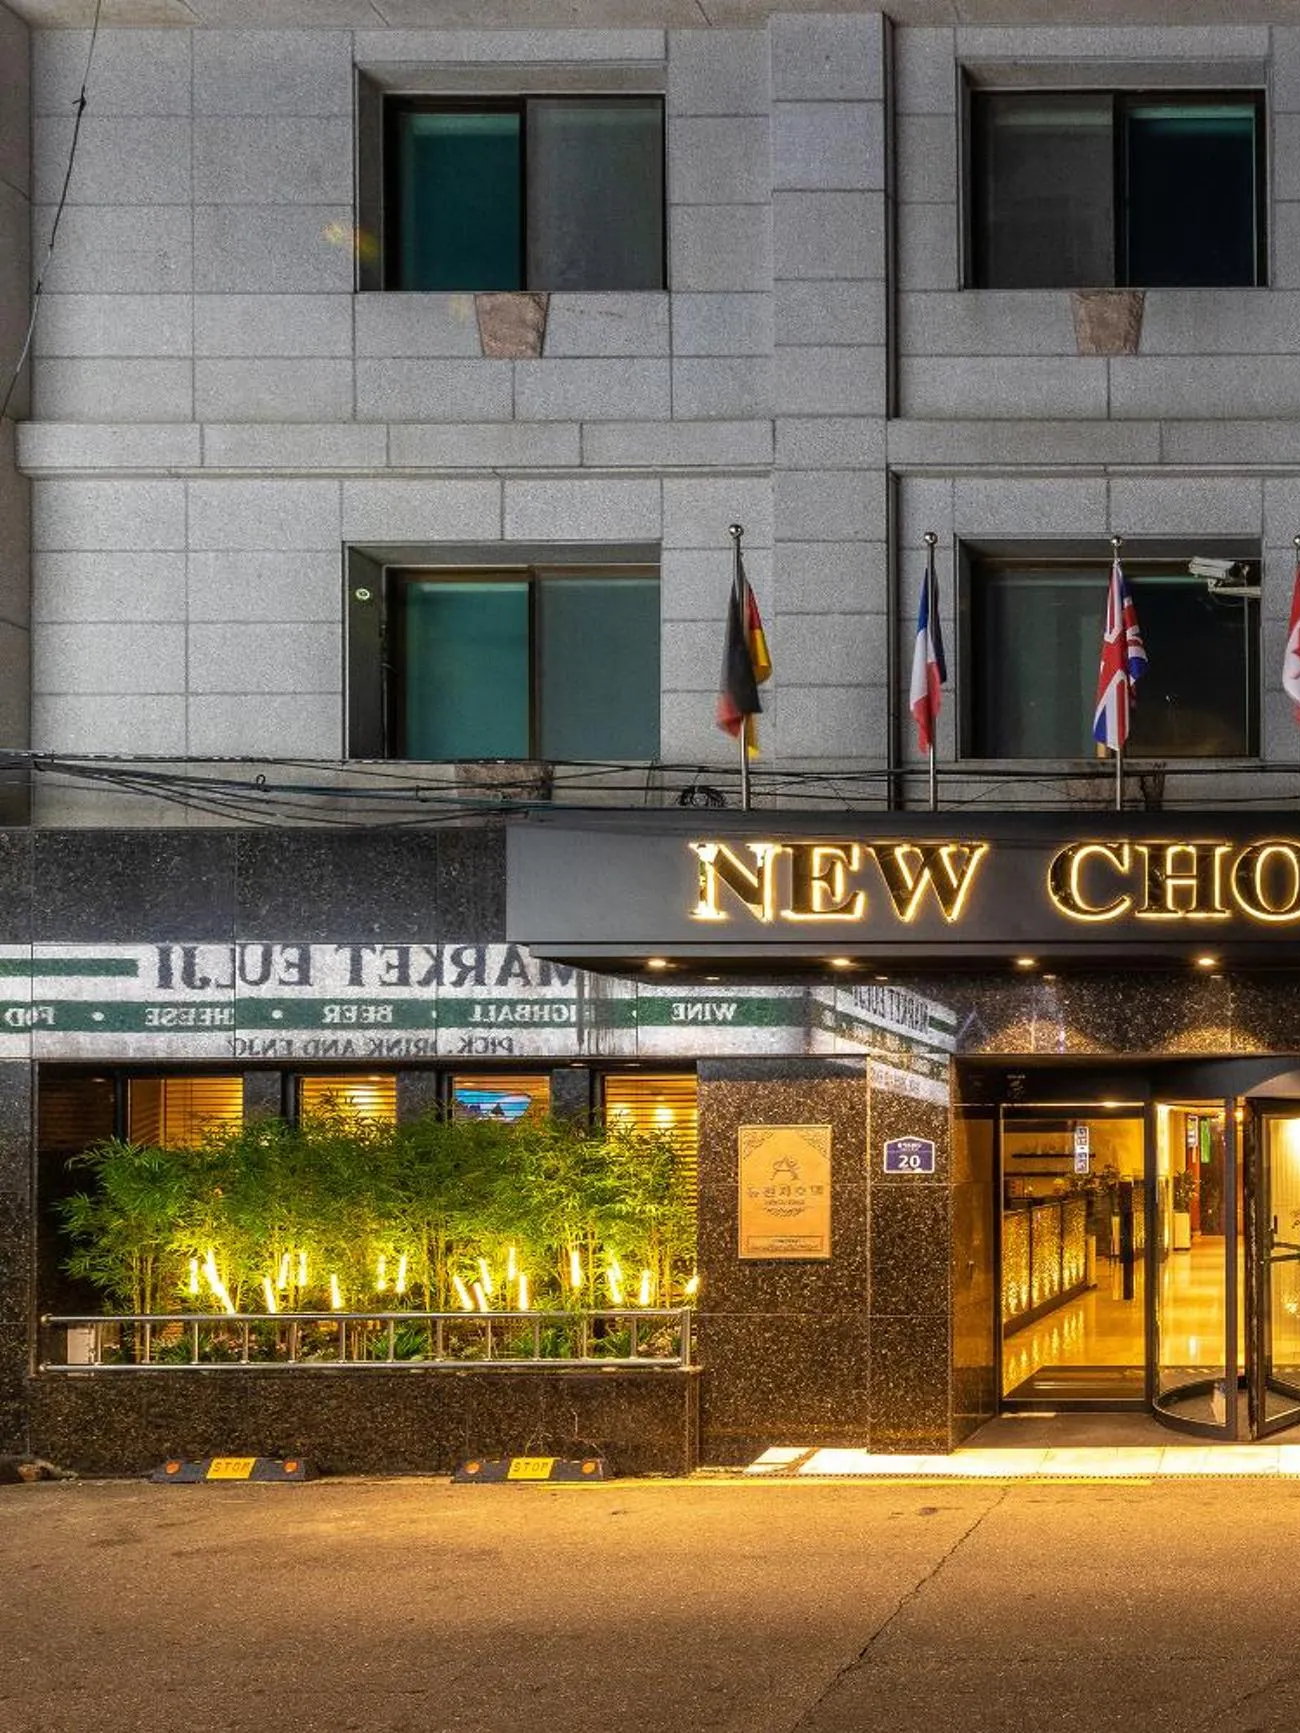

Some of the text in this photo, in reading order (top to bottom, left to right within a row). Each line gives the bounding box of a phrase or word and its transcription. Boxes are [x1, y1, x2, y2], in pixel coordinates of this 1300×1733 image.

[690, 841, 986, 923] NEW
[898, 1155, 921, 1169] 20
[213, 1461, 251, 1473] STOP
[512, 1461, 549, 1473] STOP
